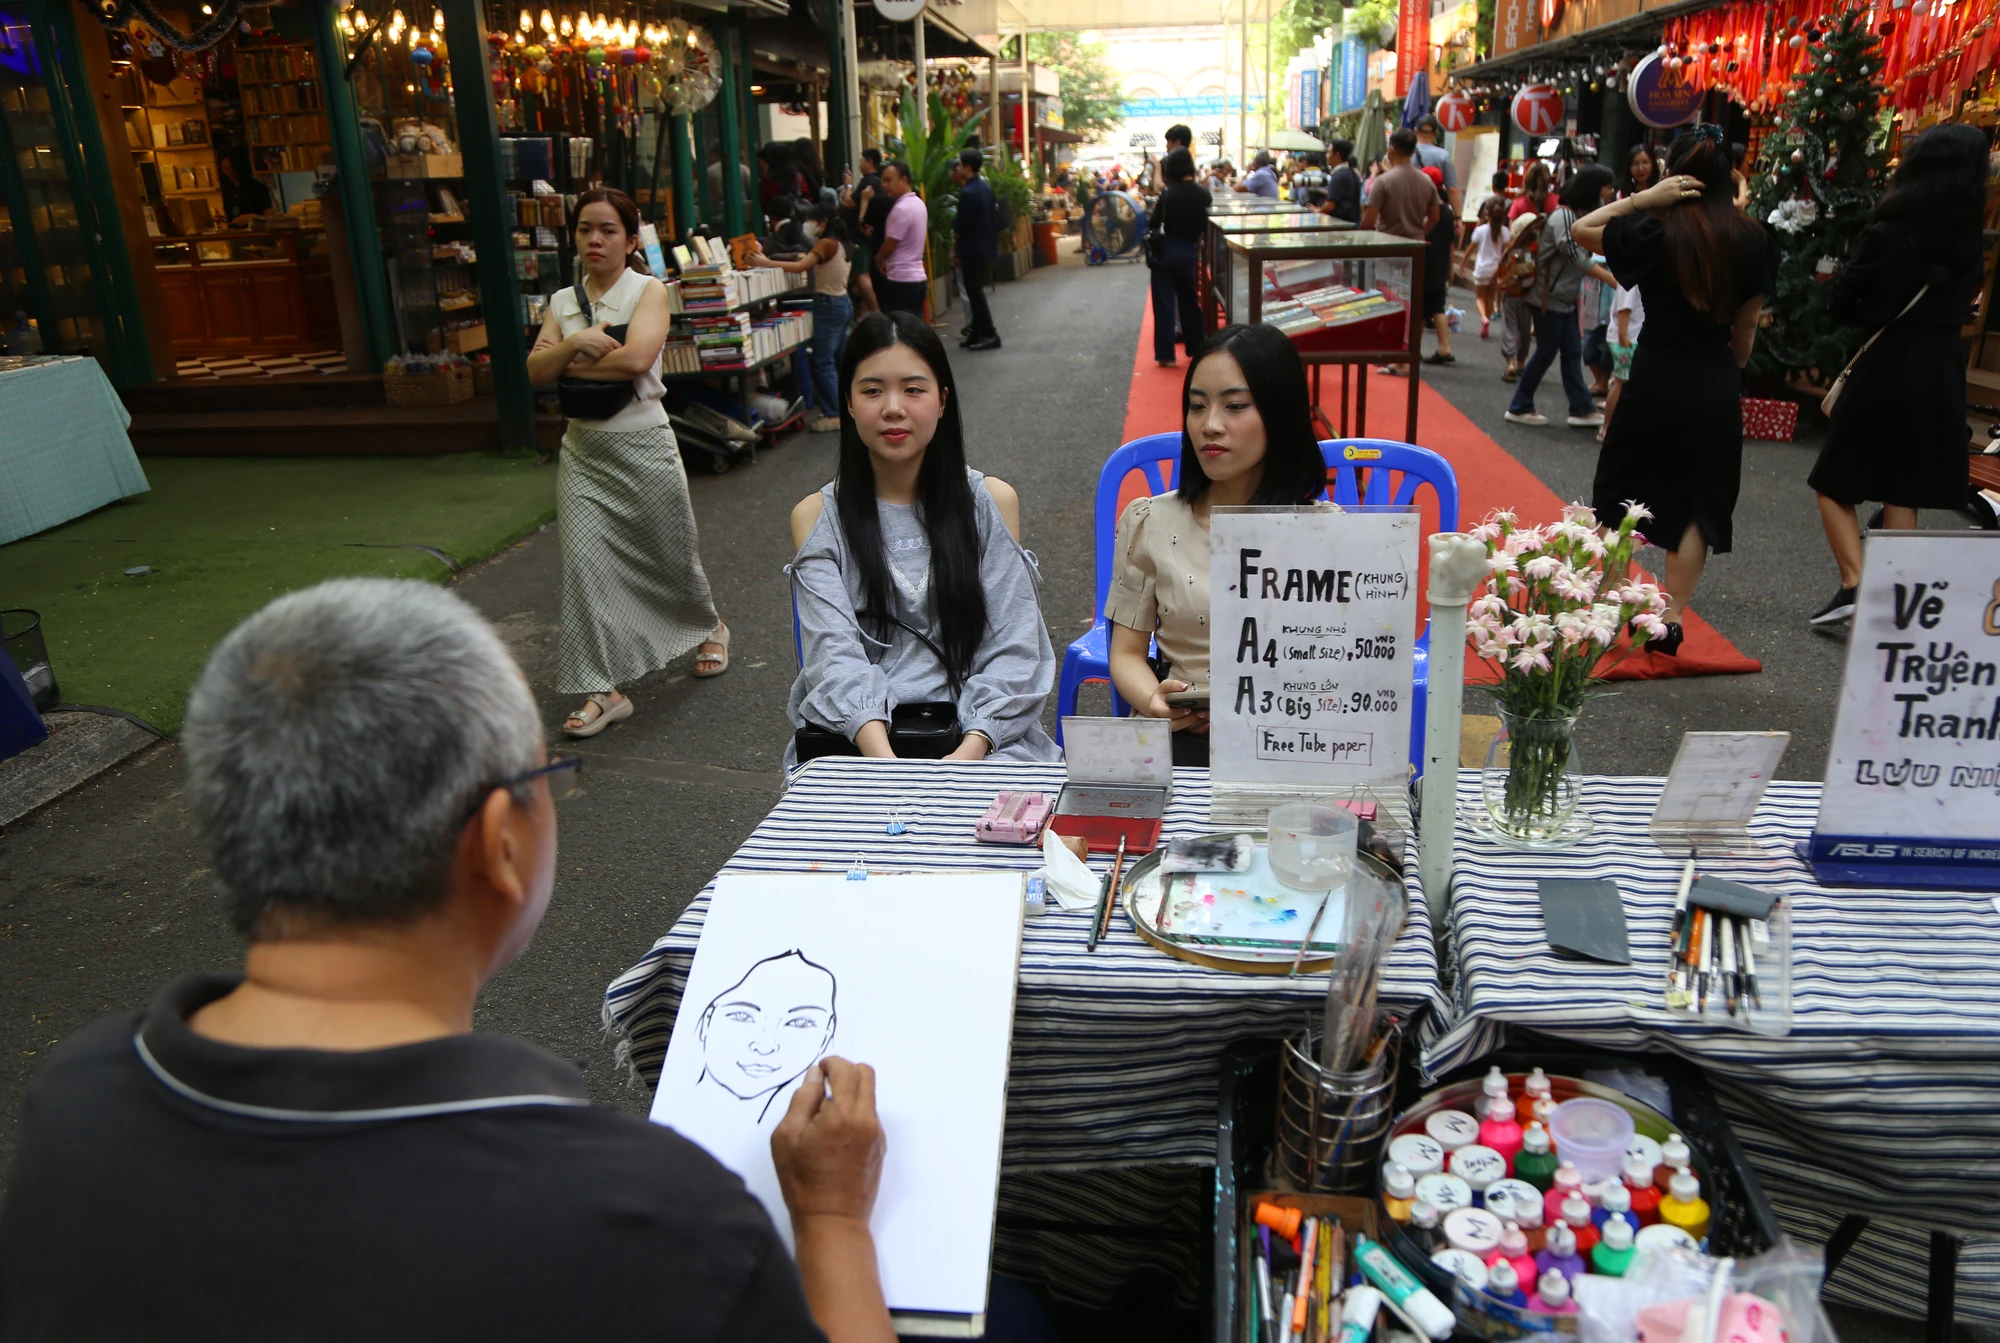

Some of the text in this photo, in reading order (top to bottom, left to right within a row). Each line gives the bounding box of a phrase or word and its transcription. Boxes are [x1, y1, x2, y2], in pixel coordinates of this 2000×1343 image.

[1240, 548, 1353, 603] FRAME
[1893, 581, 1949, 630] Vẽ
[1375, 635, 1396, 644] VND
[1377, 690, 1396, 699] VND
[1298, 732, 1326, 752] Tube
[1828, 843, 1898, 858] ASUS
[1901, 846, 1912, 857] IN
[1914, 847, 1950, 858] SEARCH
[1952, 848, 1966, 859] OF
